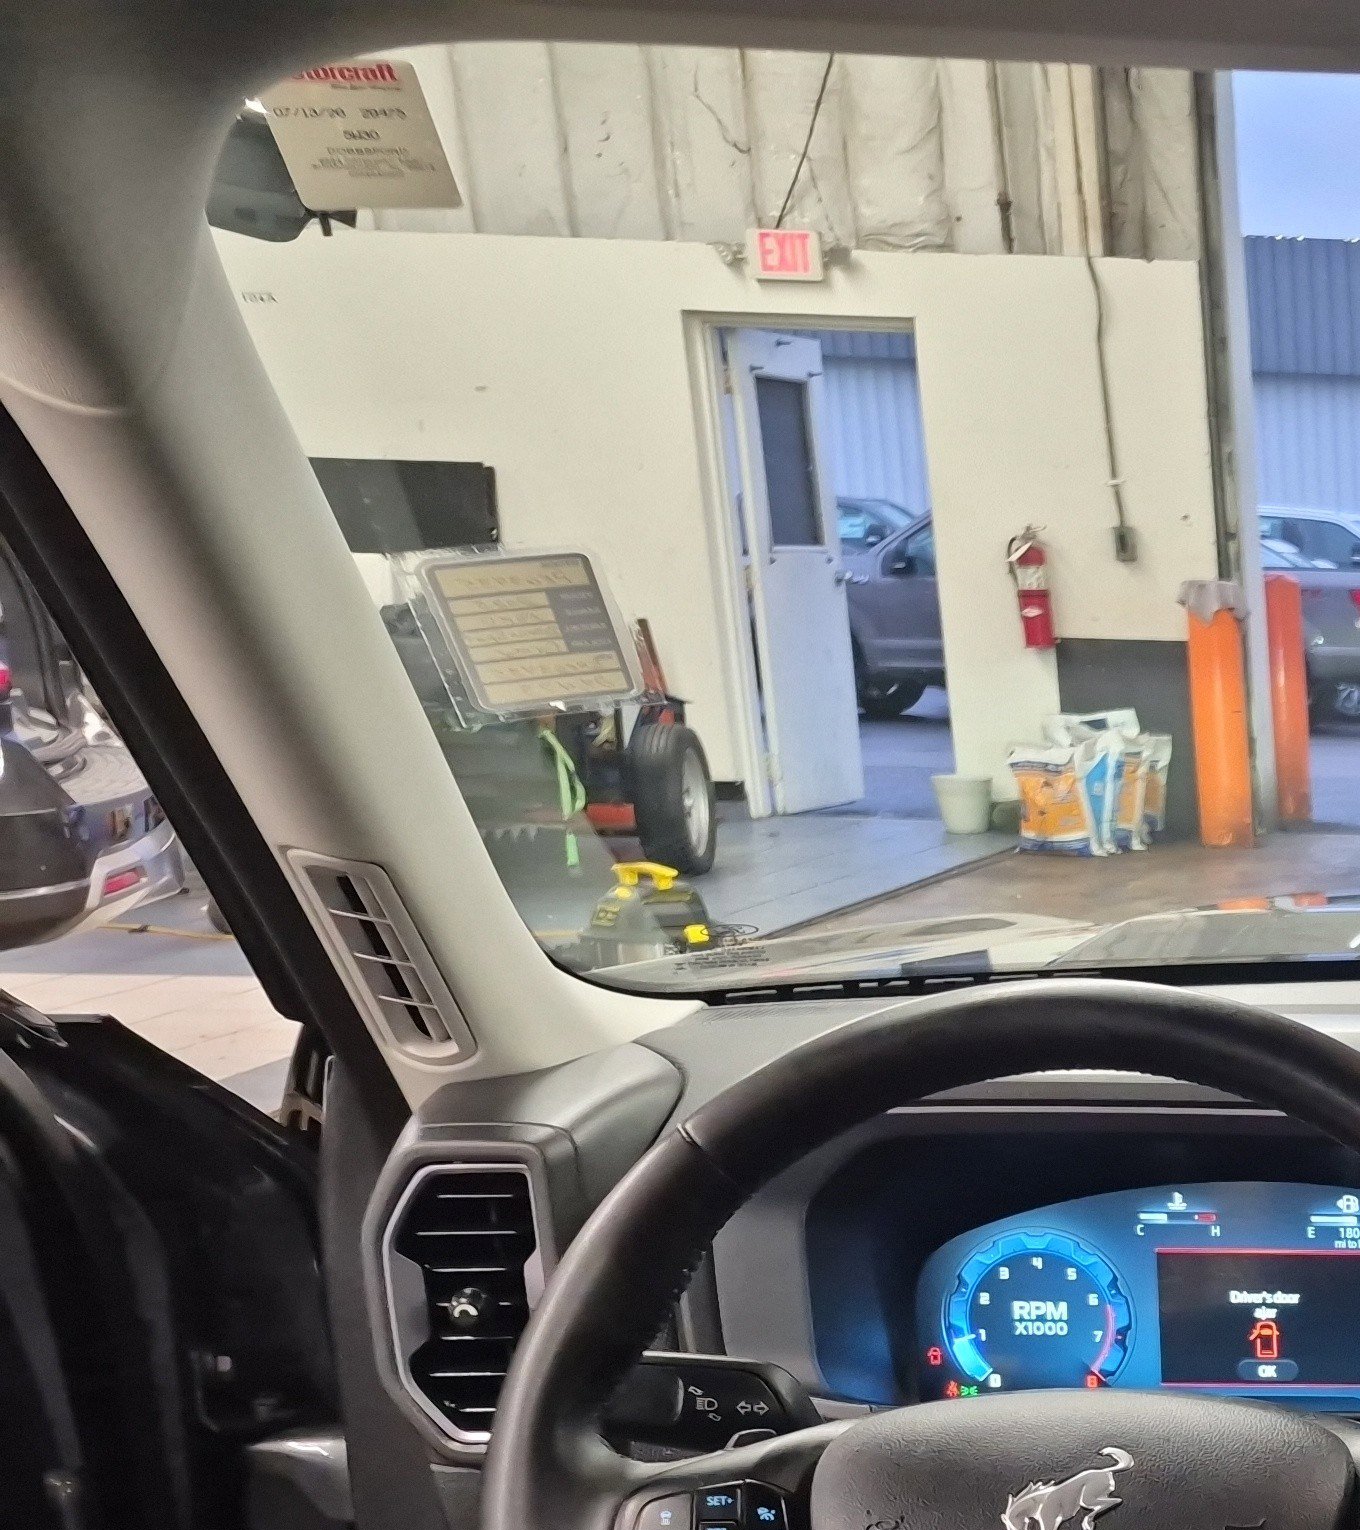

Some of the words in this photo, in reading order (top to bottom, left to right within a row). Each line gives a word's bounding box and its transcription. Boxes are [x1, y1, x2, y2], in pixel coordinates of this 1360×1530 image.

[759, 233, 810, 273] EXIT
[1136, 1225, 1145, 1236] C
[1211, 1226, 1221, 1237] H
[1307, 1227, 1316, 1239] E
[1338, 1228, 1360, 1239] 180
[1032, 1257, 1043, 1269] 4
[999, 1267, 1009, 1280] 3
[1067, 1268, 1077, 1280] 5
[979, 1292, 990, 1305] 2
[1089, 1293, 1099, 1306] 6
[1229, 1291, 1272, 1304] Driver's
[1273, 1291, 1300, 1304] door
[1012, 1301, 1068, 1321] RPM
[1014, 1321, 1069, 1336] X1000
[978, 1329, 987, 1342] 1
[1092, 1330, 1103, 1343] 7
[1257, 1365, 1277, 1378] OK
[706, 1495, 735, 1507] SET+
